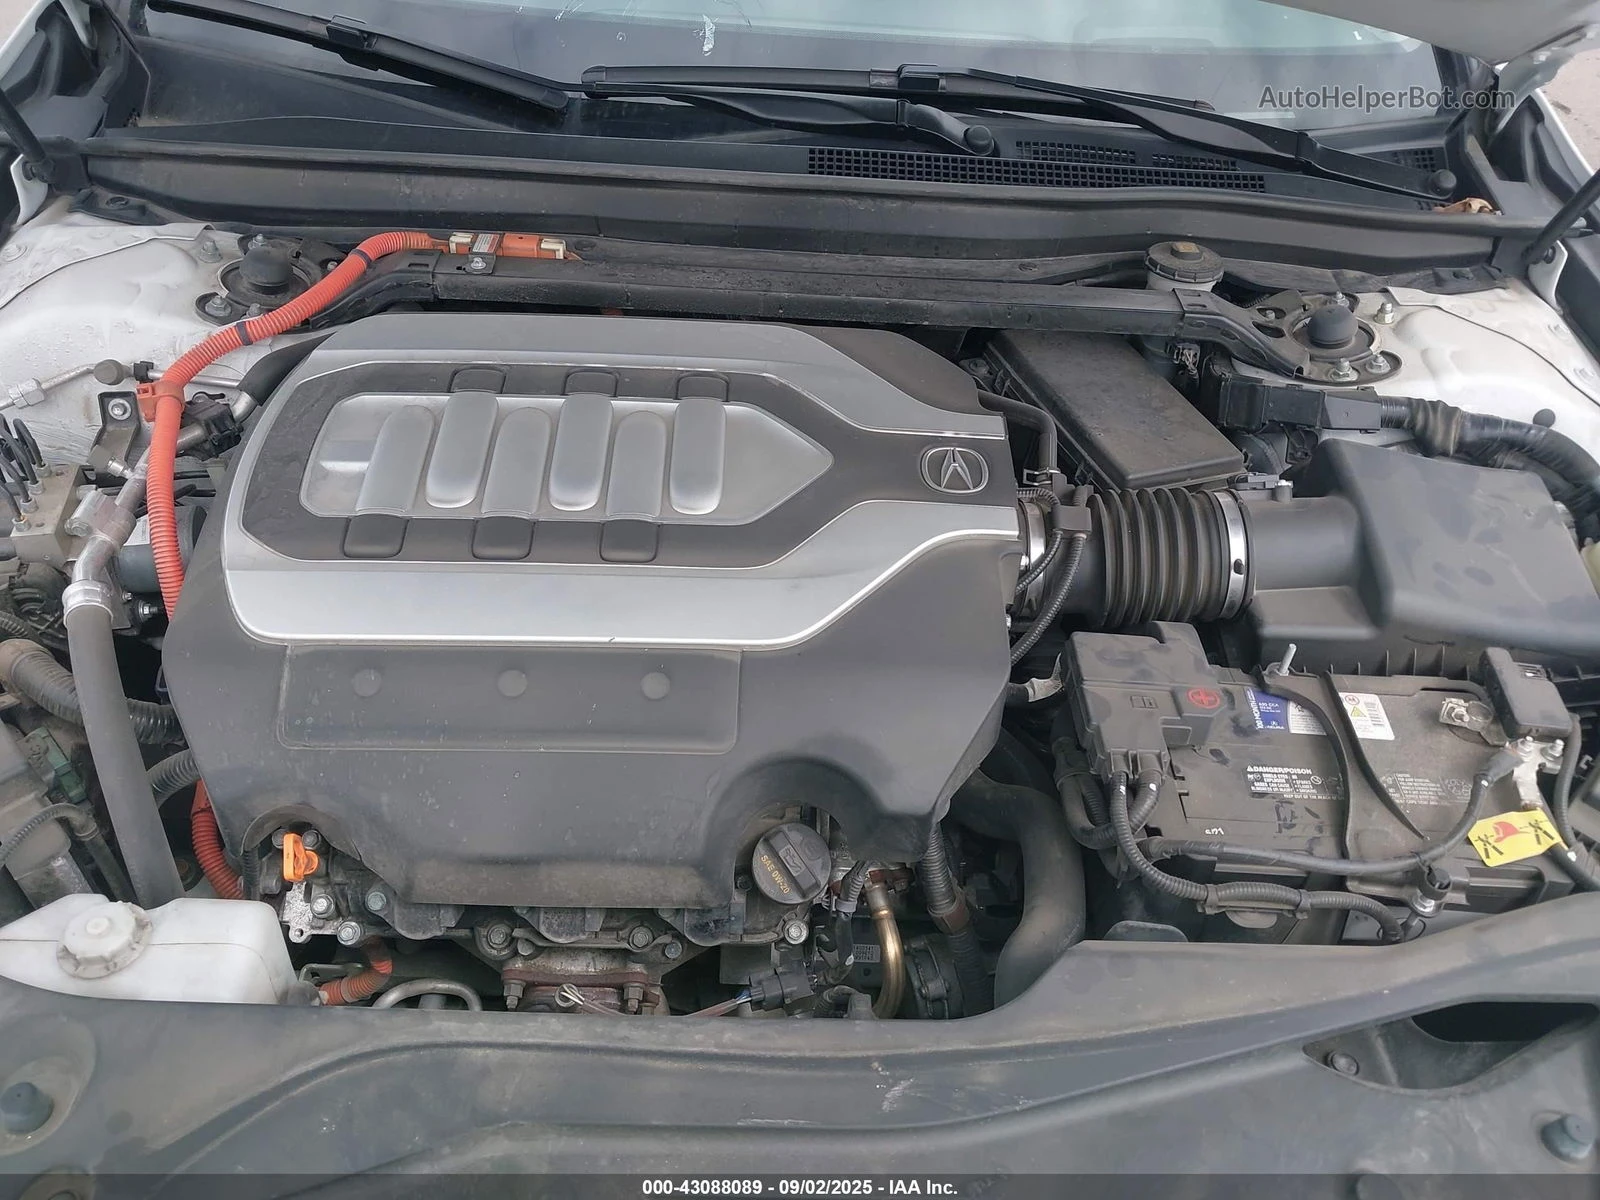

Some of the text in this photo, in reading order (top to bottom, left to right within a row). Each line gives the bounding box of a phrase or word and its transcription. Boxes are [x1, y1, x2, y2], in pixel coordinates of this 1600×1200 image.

[1253, 765, 1312, 775] DANGER/POISON
[761, 855, 790, 894] SAE 0W-20
